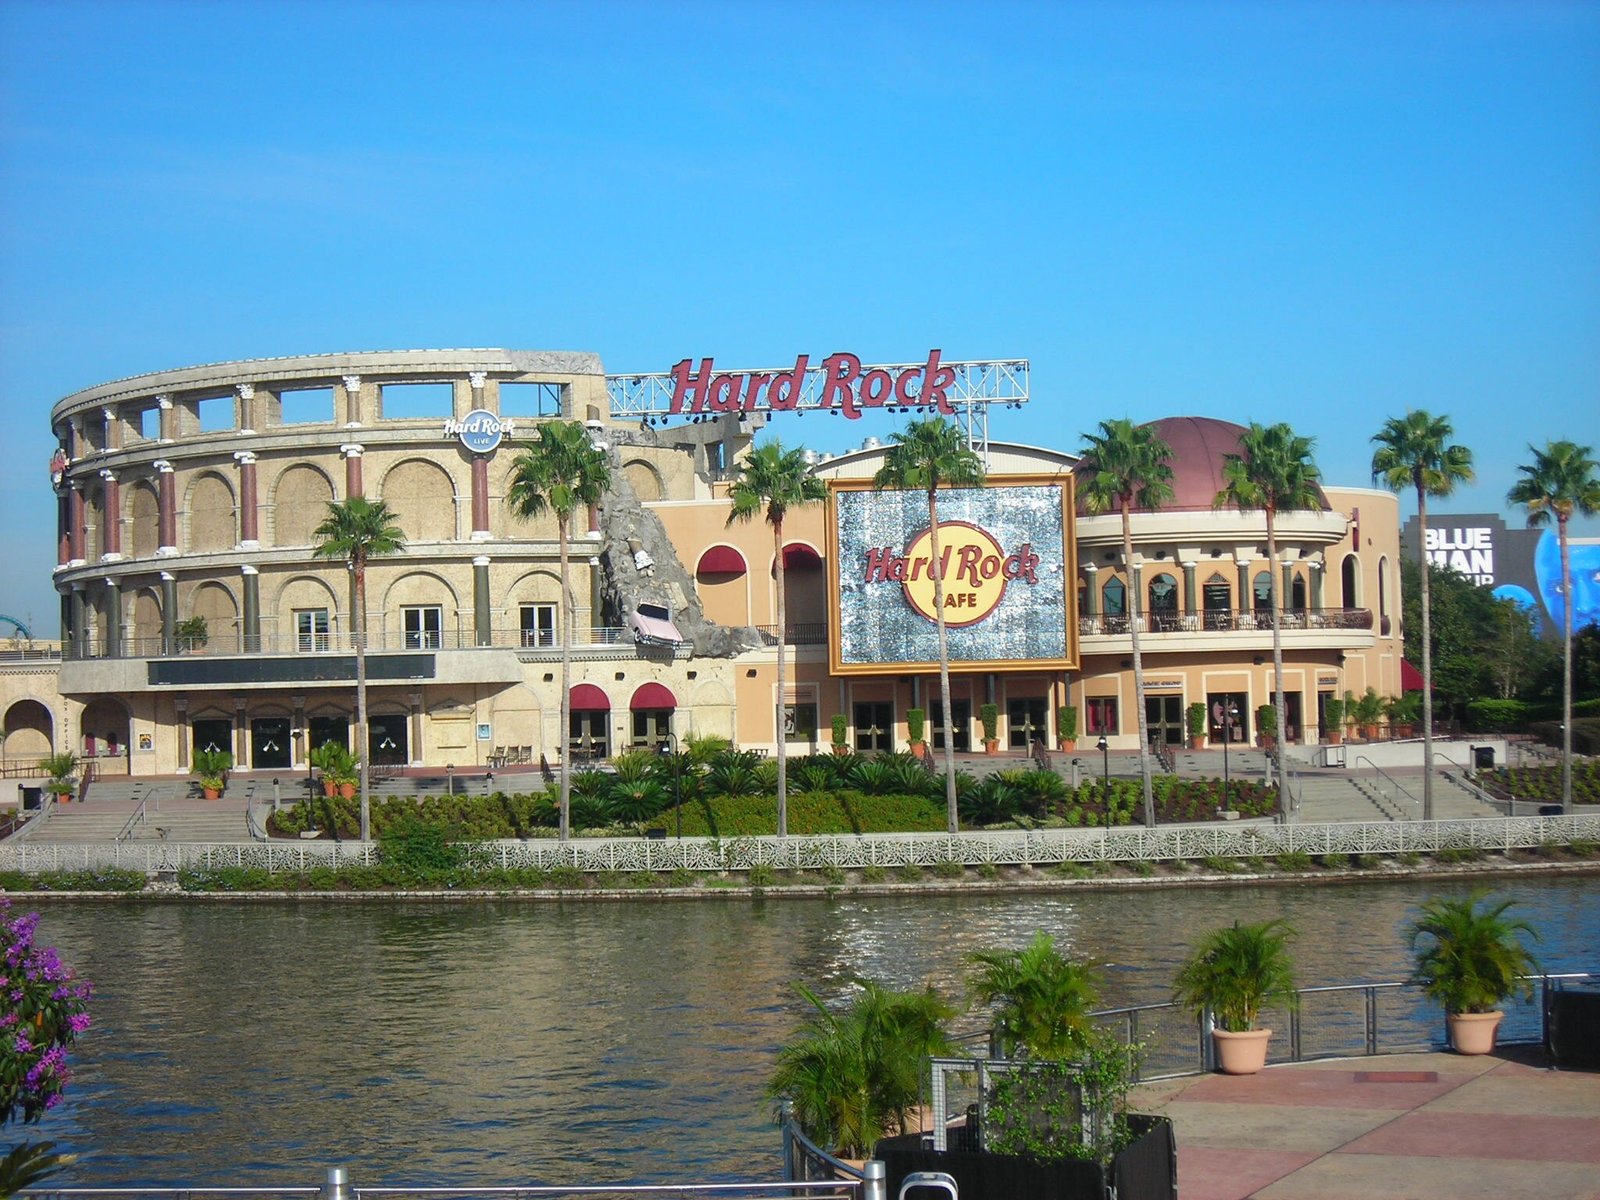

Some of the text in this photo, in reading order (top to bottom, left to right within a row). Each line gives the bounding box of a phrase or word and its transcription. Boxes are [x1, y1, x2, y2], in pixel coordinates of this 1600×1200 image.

[670, 349, 956, 420] Hard Rock
[444, 418, 515, 436] Hard Rock
[1424, 527, 1493, 550] BLUE
[865, 543, 1040, 588] Hard Rock
